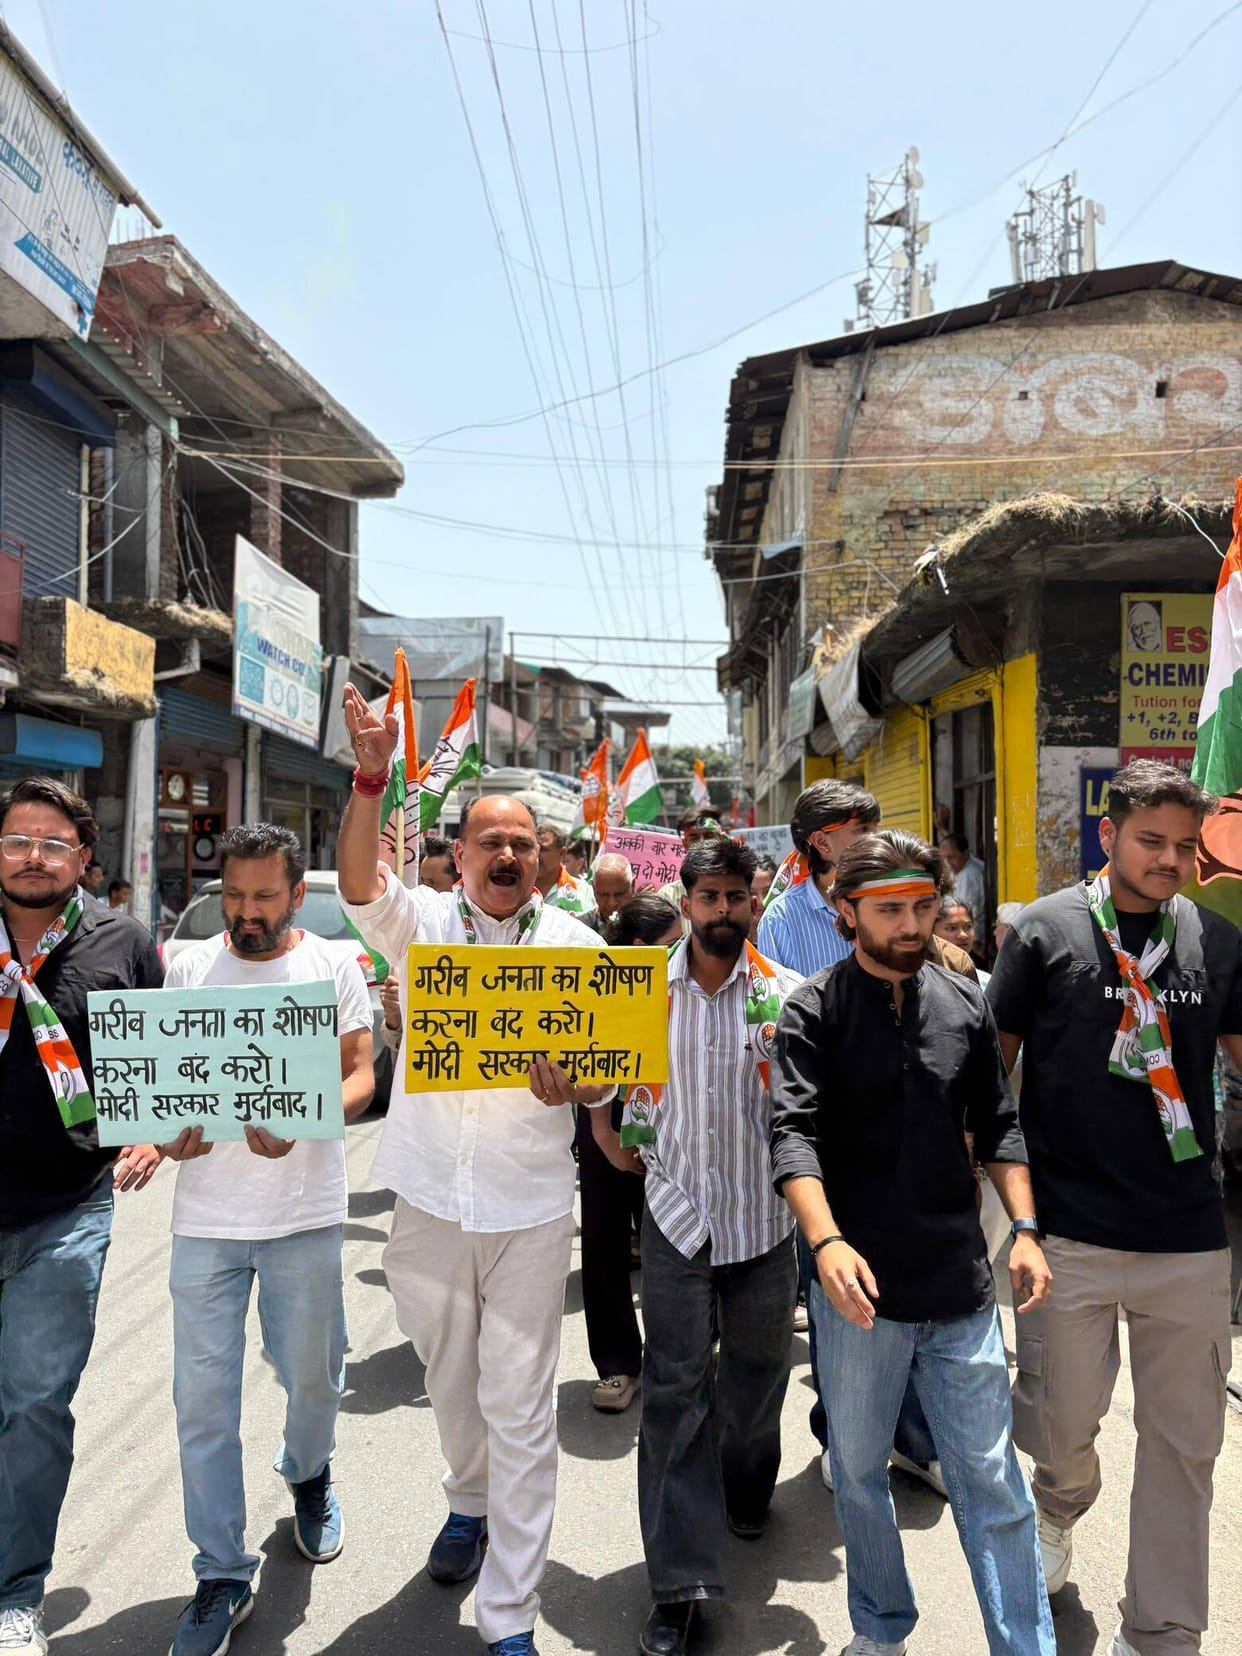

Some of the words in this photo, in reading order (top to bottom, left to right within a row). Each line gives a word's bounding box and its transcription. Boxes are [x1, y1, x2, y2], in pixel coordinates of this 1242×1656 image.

[257, 636, 290, 669] WATCH
[1166, 626, 1209, 653] ES
[1128, 662, 1208, 687] CHEMI
[1131, 695, 1177, 708] Tution
[1127, 710, 1151, 727] +1,
[1156, 711, 1182, 727] +2,
[1149, 728, 1176, 740] 6th
[1182, 729, 1198, 741] to
[413, 954, 471, 997] गरीब
[482, 965, 547, 992] जनता
[552, 966, 582, 993] का
[588, 952, 655, 996] शोषण
[1104, 986, 1202, 1004] BRKLYN
[89, 998, 146, 1041] गरीब
[159, 1009, 225, 1038] जनता
[234, 1009, 266, 1036] का
[273, 996, 338, 1037] शोषण
[411, 1009, 478, 1039] करना
[93, 1057, 157, 1085] करना
[178, 1053, 210, 1084] बंद
[412, 1040, 464, 1081] मोदी
[96, 1087, 140, 1122] मोदी
[152, 1093, 220, 1121] सरकार
